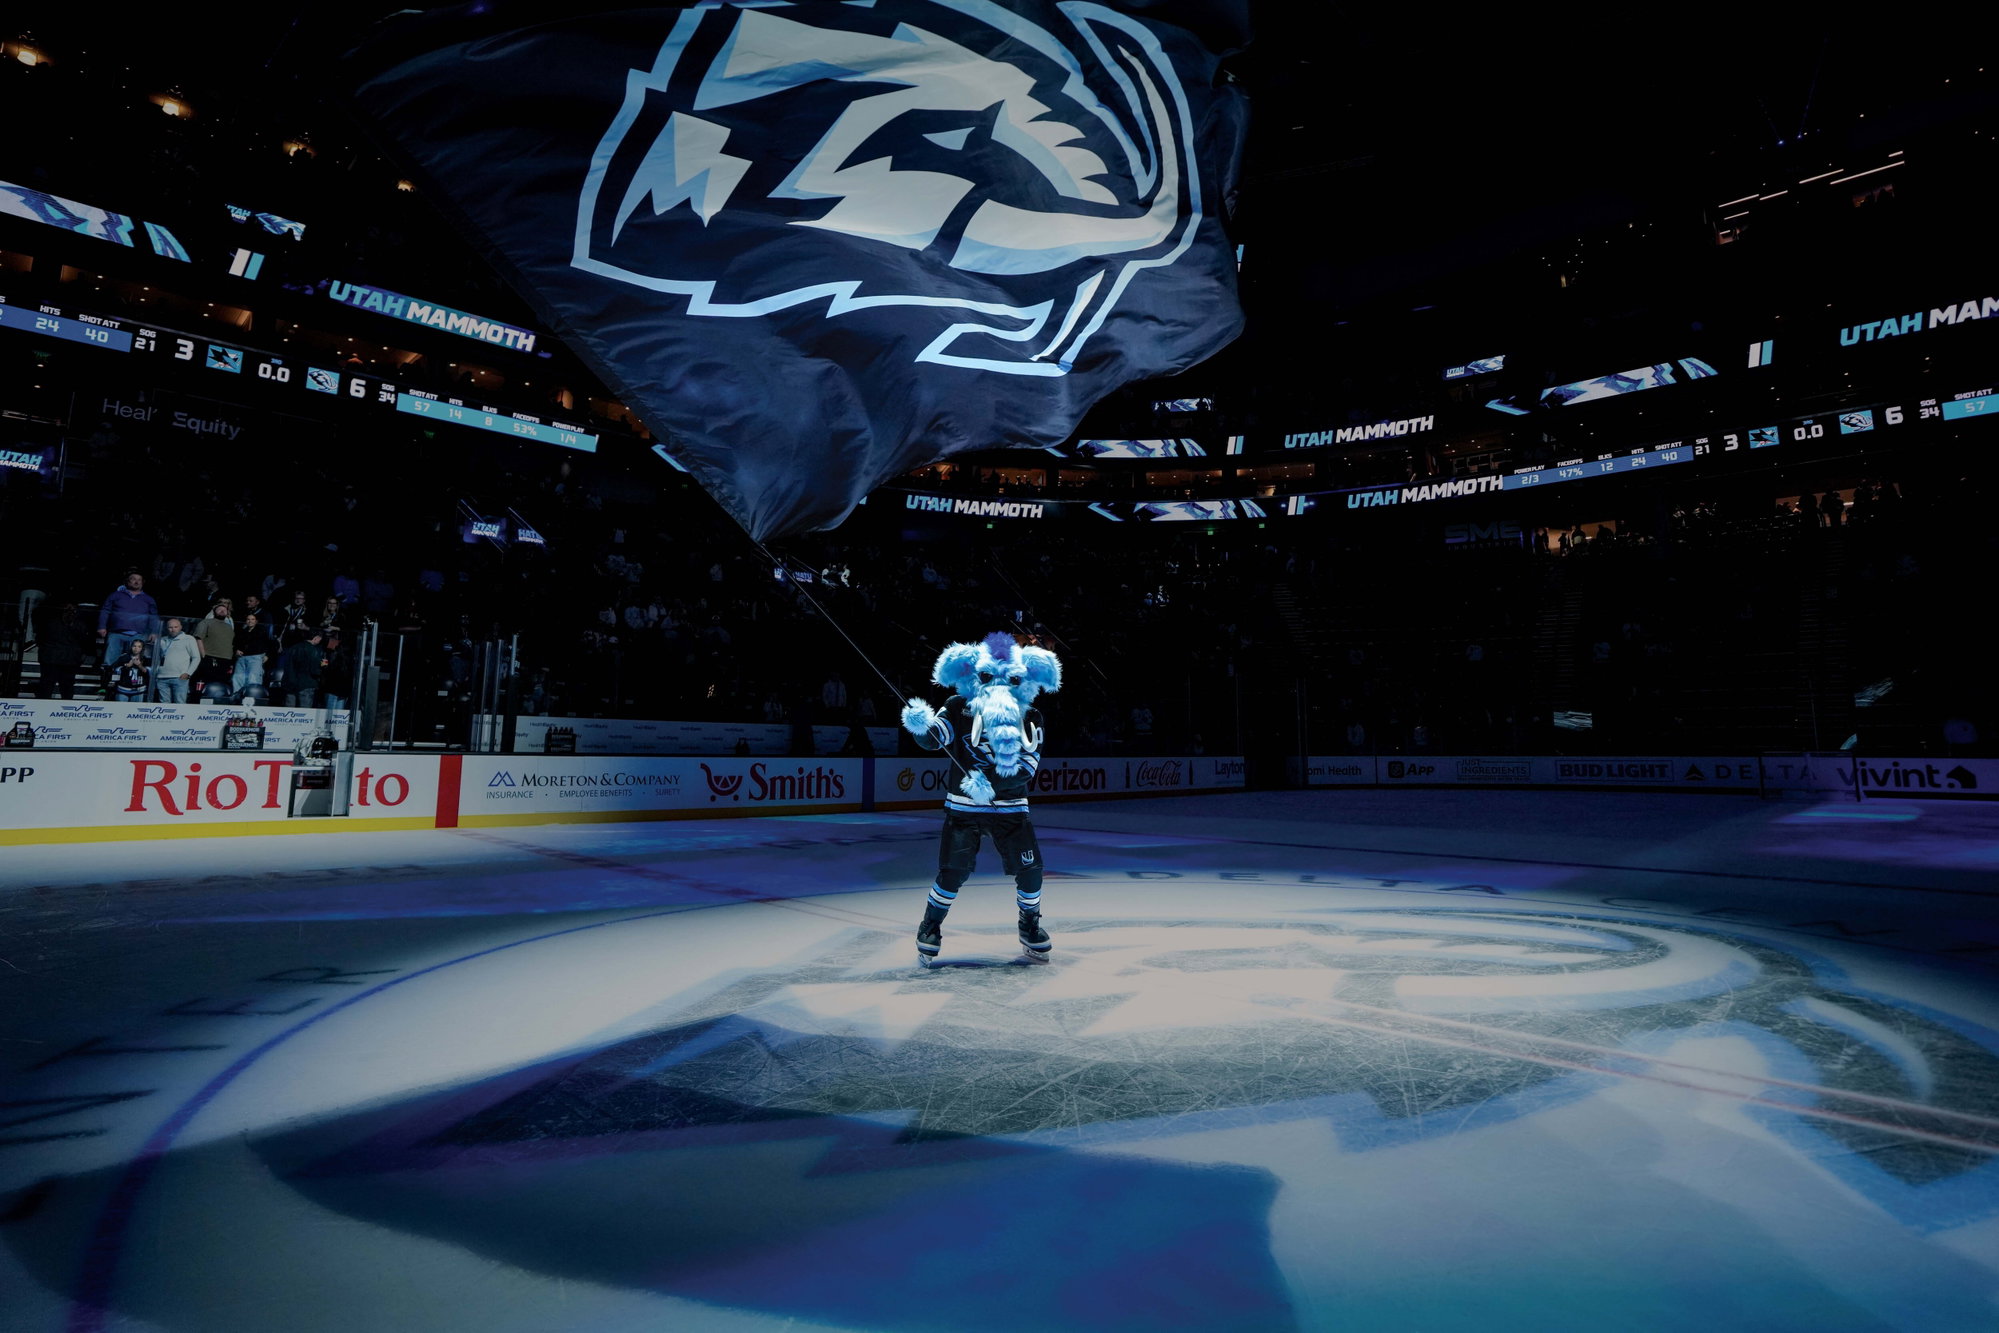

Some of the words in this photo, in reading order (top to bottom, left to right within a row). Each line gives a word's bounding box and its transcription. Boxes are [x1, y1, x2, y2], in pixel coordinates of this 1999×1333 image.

[39, 305, 61, 316] HITS
[328, 280, 405, 316] UTAH
[406, 302, 537, 352] MAMMOTH
[35, 317, 60, 332] 24
[78, 314, 103, 326] SHOT
[102, 319, 121, 329] ATT
[139, 328, 157, 338] SOG
[1840, 311, 1923, 347] UTAH
[85, 328, 109, 344] 40
[134, 337, 156, 352] 21
[174, 338, 195, 361] 3
[257, 362, 291, 383] 0.0
[349, 377, 367, 398] 6
[381, 383, 396, 392] SOG
[378, 391, 396, 404] 34
[425, 392, 439, 401] ATT
[1954, 391, 1976, 401] SHOT
[1976, 388, 1993, 397] ATT
[414, 401, 431, 412] 57
[1919, 398, 1937, 407] SOG
[1965, 400, 1986, 413] 57
[448, 408, 462, 419] 14
[1885, 405, 1904, 425] 6
[1919, 406, 1941, 419] 34
[513, 423, 537, 436] 53%
[1284, 429, 1334, 449] UTAH
[1335, 415, 1435, 444] MAMMOTH
[1793, 424, 1824, 441] 0.0
[560, 433, 577, 445] 1/4
[1695, 437, 1709, 445] SOG
[1723, 433, 1739, 452] 3
[1661, 451, 1678, 461] 40
[1695, 444, 1710, 456] 21
[0, 450, 43, 465] UTAH
[1631, 456, 1646, 467] 24
[1559, 467, 1584, 478] 47%
[1600, 462, 1614, 472] 12
[1521, 474, 1540, 485] 2/3
[1347, 490, 1399, 510] UTAH
[1400, 475, 1504, 503] MAMMOTH
[906, 494, 953, 513] UTAH
[953, 499, 1044, 519] MAMMOTH
[472, 521, 500, 534] UTAH
[0, 767, 34, 783] PP
[1215, 760, 1246, 778] Layton
[1328, 764, 1362, 776] Health
[1461, 766, 1527, 775] INGREDIENTS
[1559, 764, 1603, 778] BUD
[1606, 764, 1669, 778] LIGHT
[1715, 764, 1818, 780] DELTA
[600, 772, 613, 787] &
[748, 762, 844, 801] Smith's
[486, 790, 534, 799] INSURANCE
[559, 789, 599, 798] EMPLOYEE
[600, 788, 633, 797] BENEFITS
